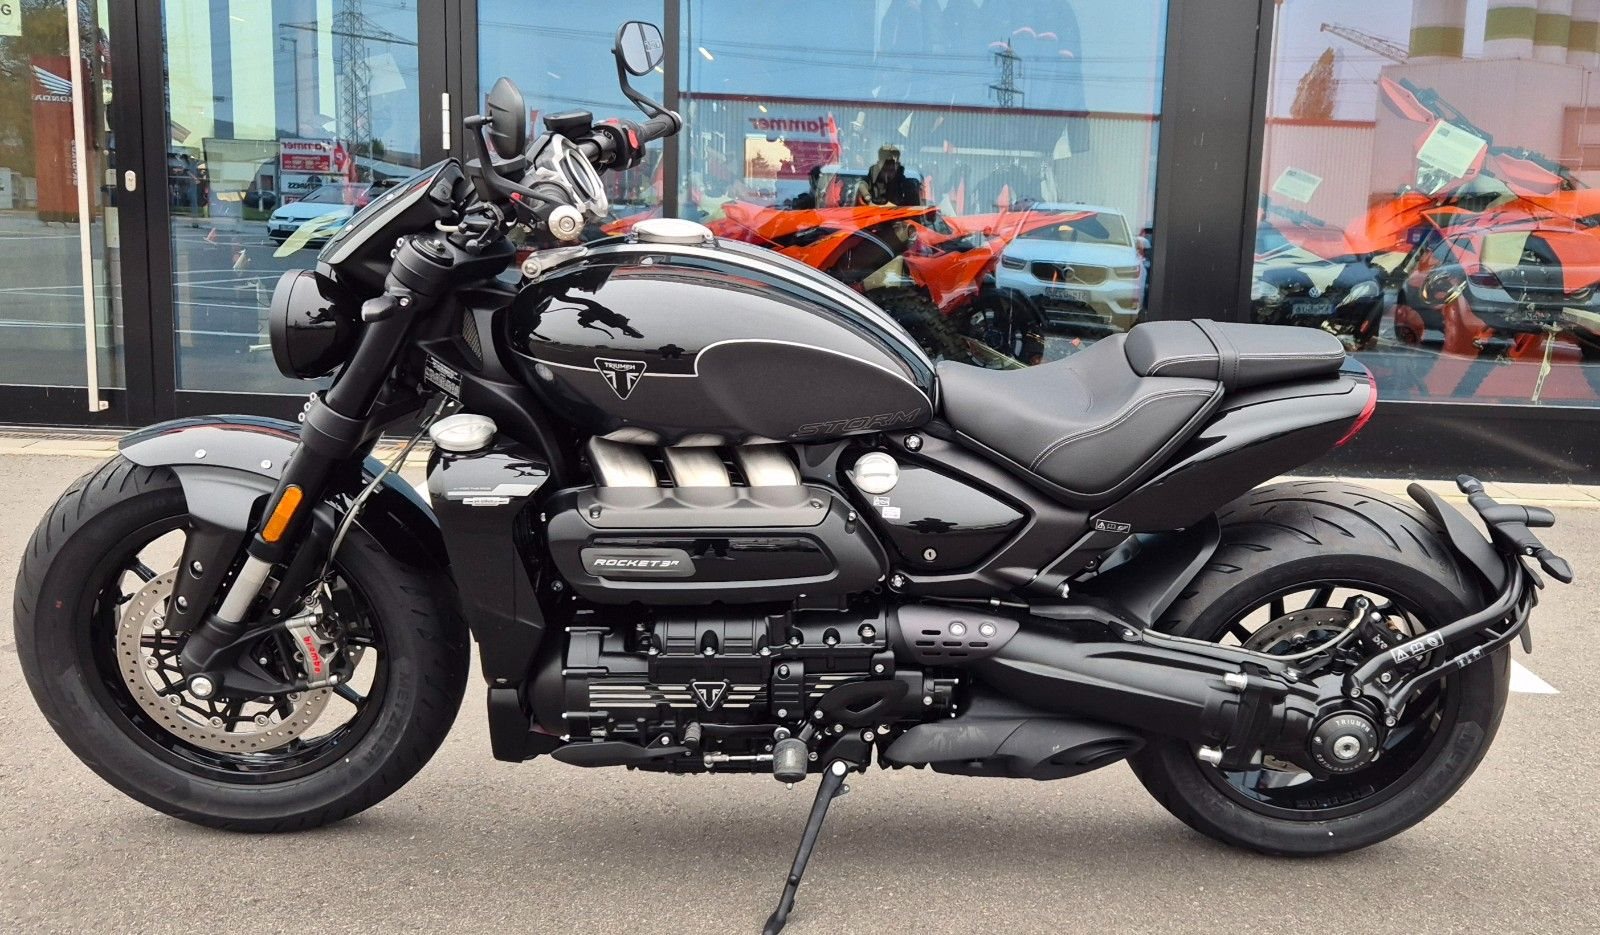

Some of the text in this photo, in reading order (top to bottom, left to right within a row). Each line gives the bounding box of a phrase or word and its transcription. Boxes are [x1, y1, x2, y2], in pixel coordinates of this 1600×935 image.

[604, 362, 636, 370] TRIUMPH
[798, 408, 921, 436] STORM
[1372, 633, 1388, 650] bre
[303, 635, 321, 673] brembo
[1335, 719, 1371, 733] TRIUMPH
